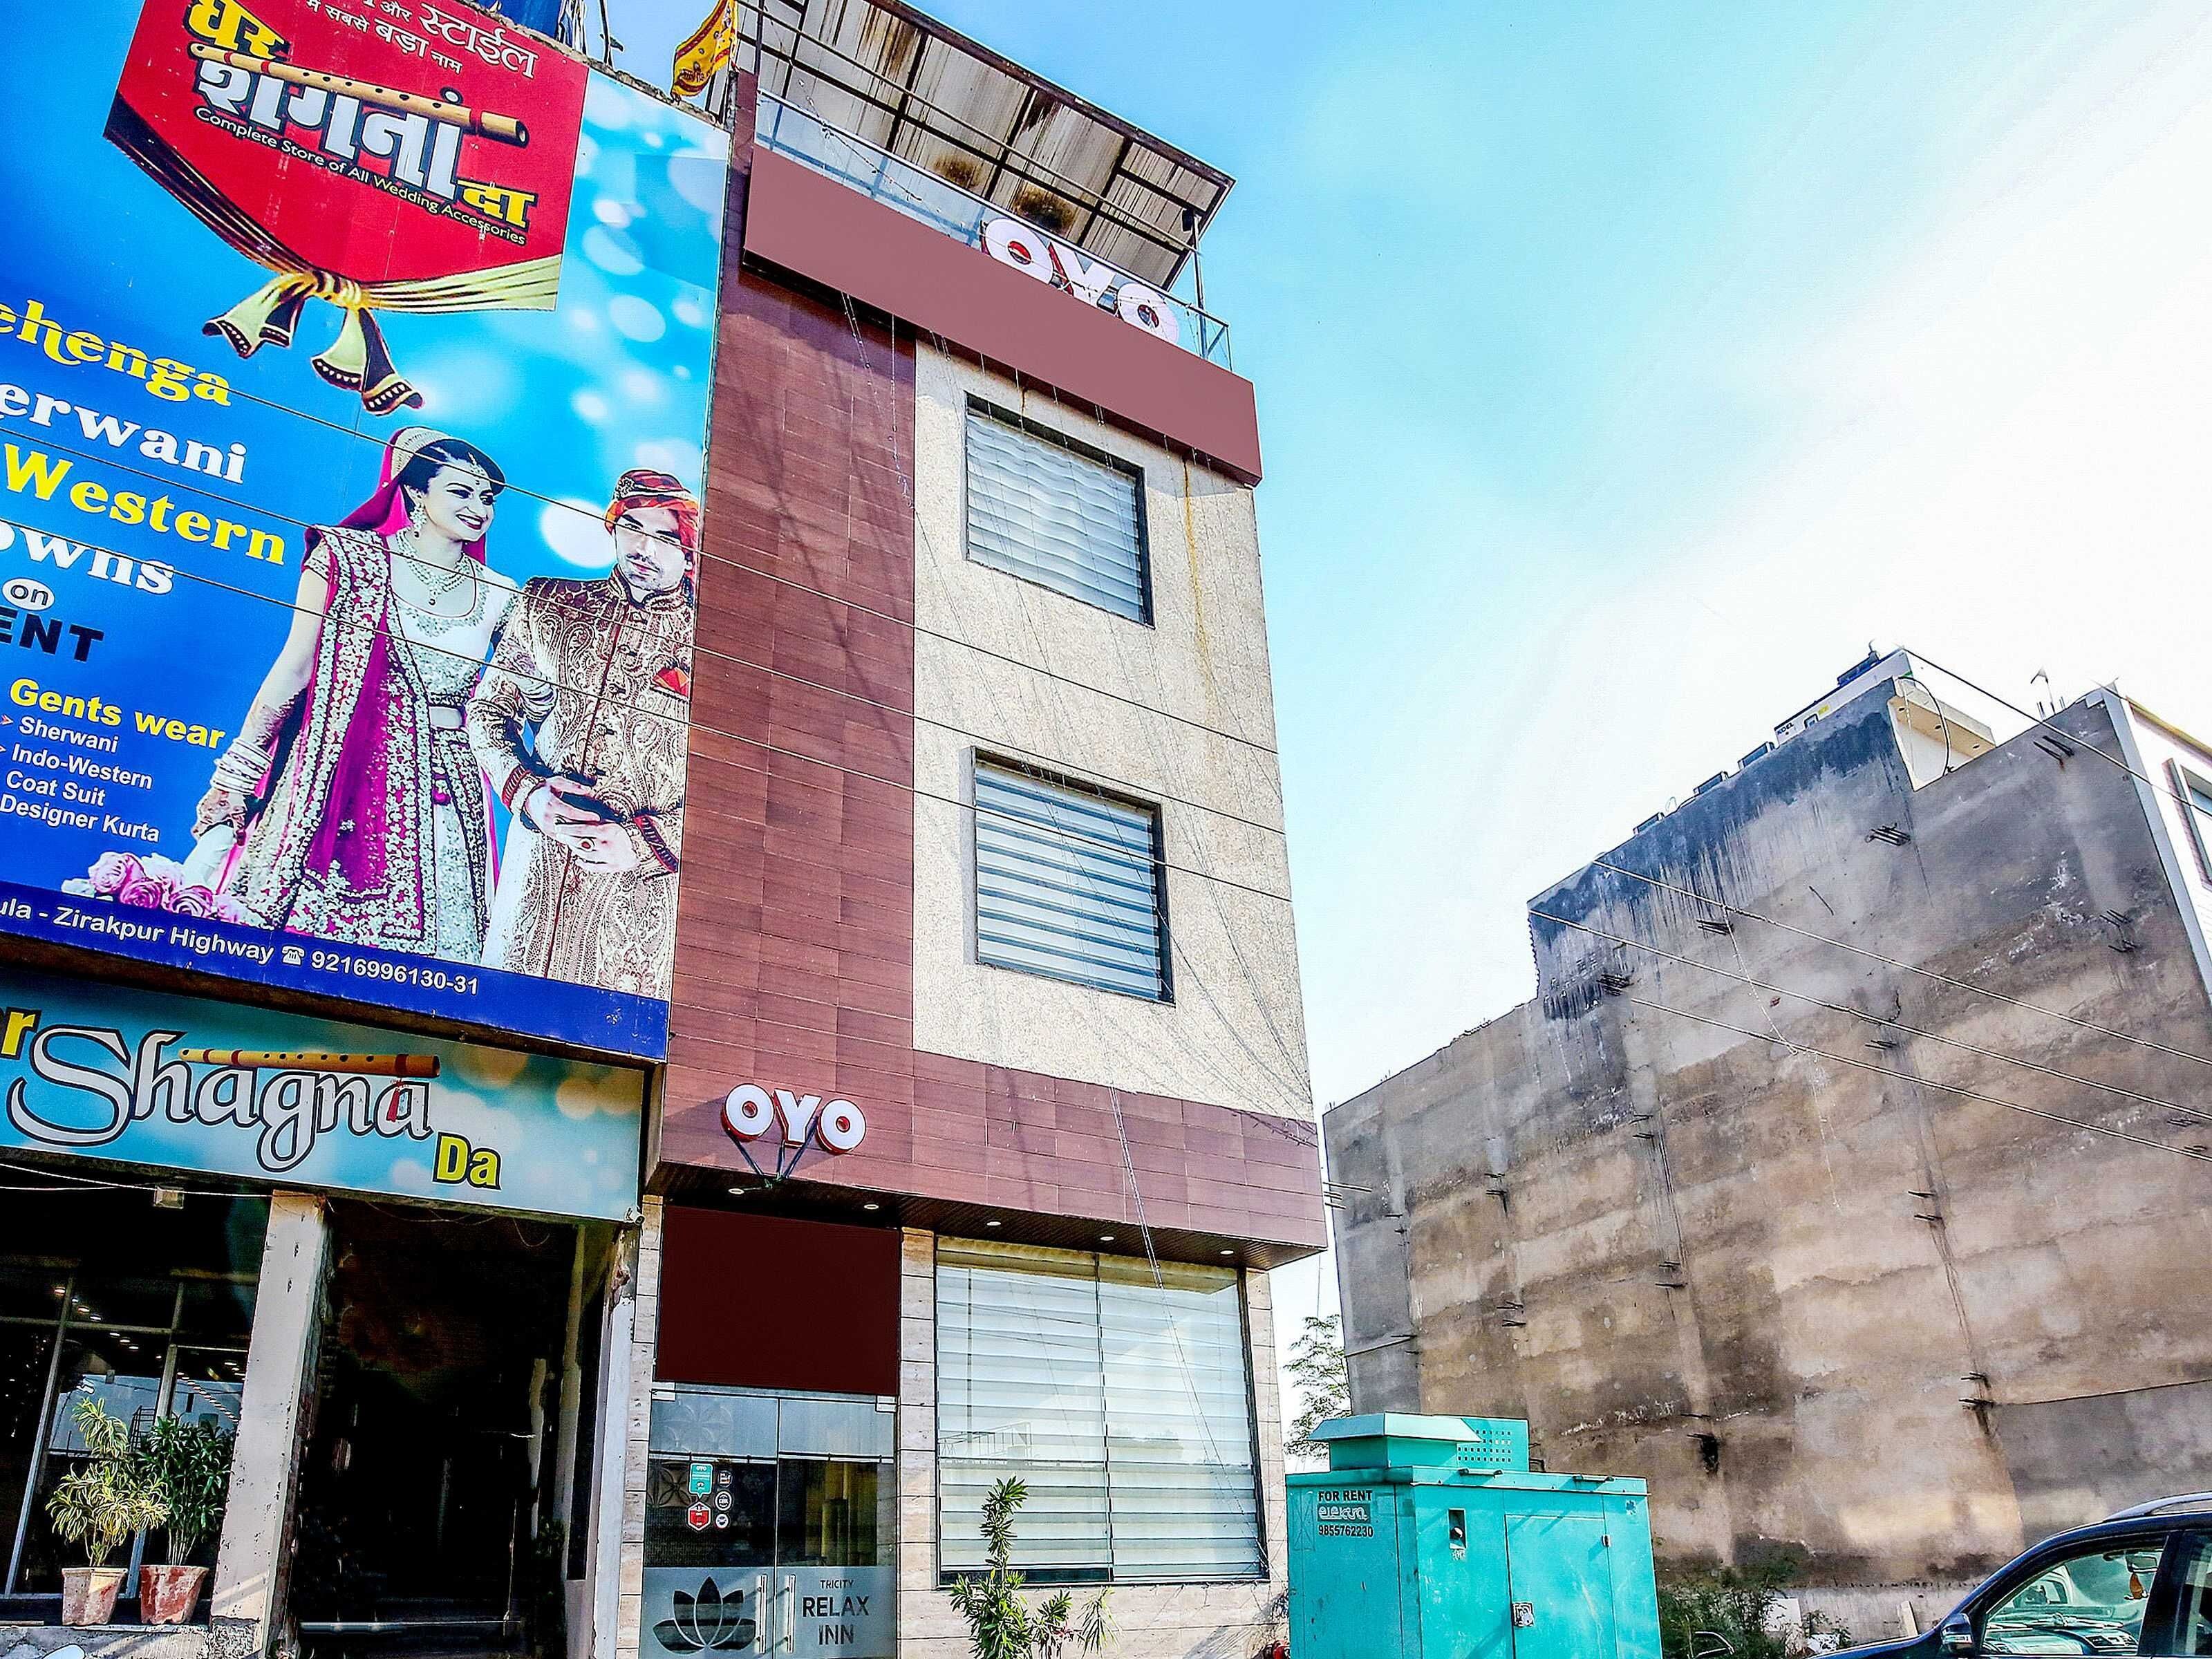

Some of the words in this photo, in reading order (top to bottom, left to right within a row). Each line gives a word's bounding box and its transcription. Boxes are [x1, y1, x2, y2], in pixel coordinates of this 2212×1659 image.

[325, 4, 370, 32] सबसे
[373, 19, 429, 58] बड़ा
[431, 50, 462, 73] नाम
[196, 107, 278, 147] Complete
[281, 140, 324, 166] Store
[328, 161, 347, 173] of
[348, 167, 368, 183] All
[374, 175, 439, 213] Wedding
[441, 205, 526, 245] Accessories
[458, 179, 535, 228] दा
[982, 218, 1179, 345] OYO
[0, 383, 247, 484] erwani
[4, 442, 285, 565] Western
[10, 585, 48, 606] on
[10, 678, 122, 726] Gents
[134, 711, 226, 749] wear
[19, 716, 119, 753] Sherwani
[6, 770, 58, 796] Coat
[62, 782, 106, 807] Suit
[11, 743, 153, 789] Indo-Western
[0, 794, 99, 830] Designer
[102, 814, 160, 843] Kurta
[53, 906, 166, 941] Zirakpur
[170, 926, 274, 966] Highway
[311, 950, 479, 995] 9216996130-31
[8, 1025, 433, 1172] Shagna
[435, 1134, 500, 1189] Da
[721, 1083, 866, 1154] OYO
[1318, 1490, 1340, 1502] FOR
[1343, 1490, 1373, 1501] RENT
[1318, 1525, 1374, 1537] 9855762230
[803, 1596, 870, 1617] RELAX
[820, 1580, 854, 1588] TRICITY
[818, 1624, 854, 1645] INN
